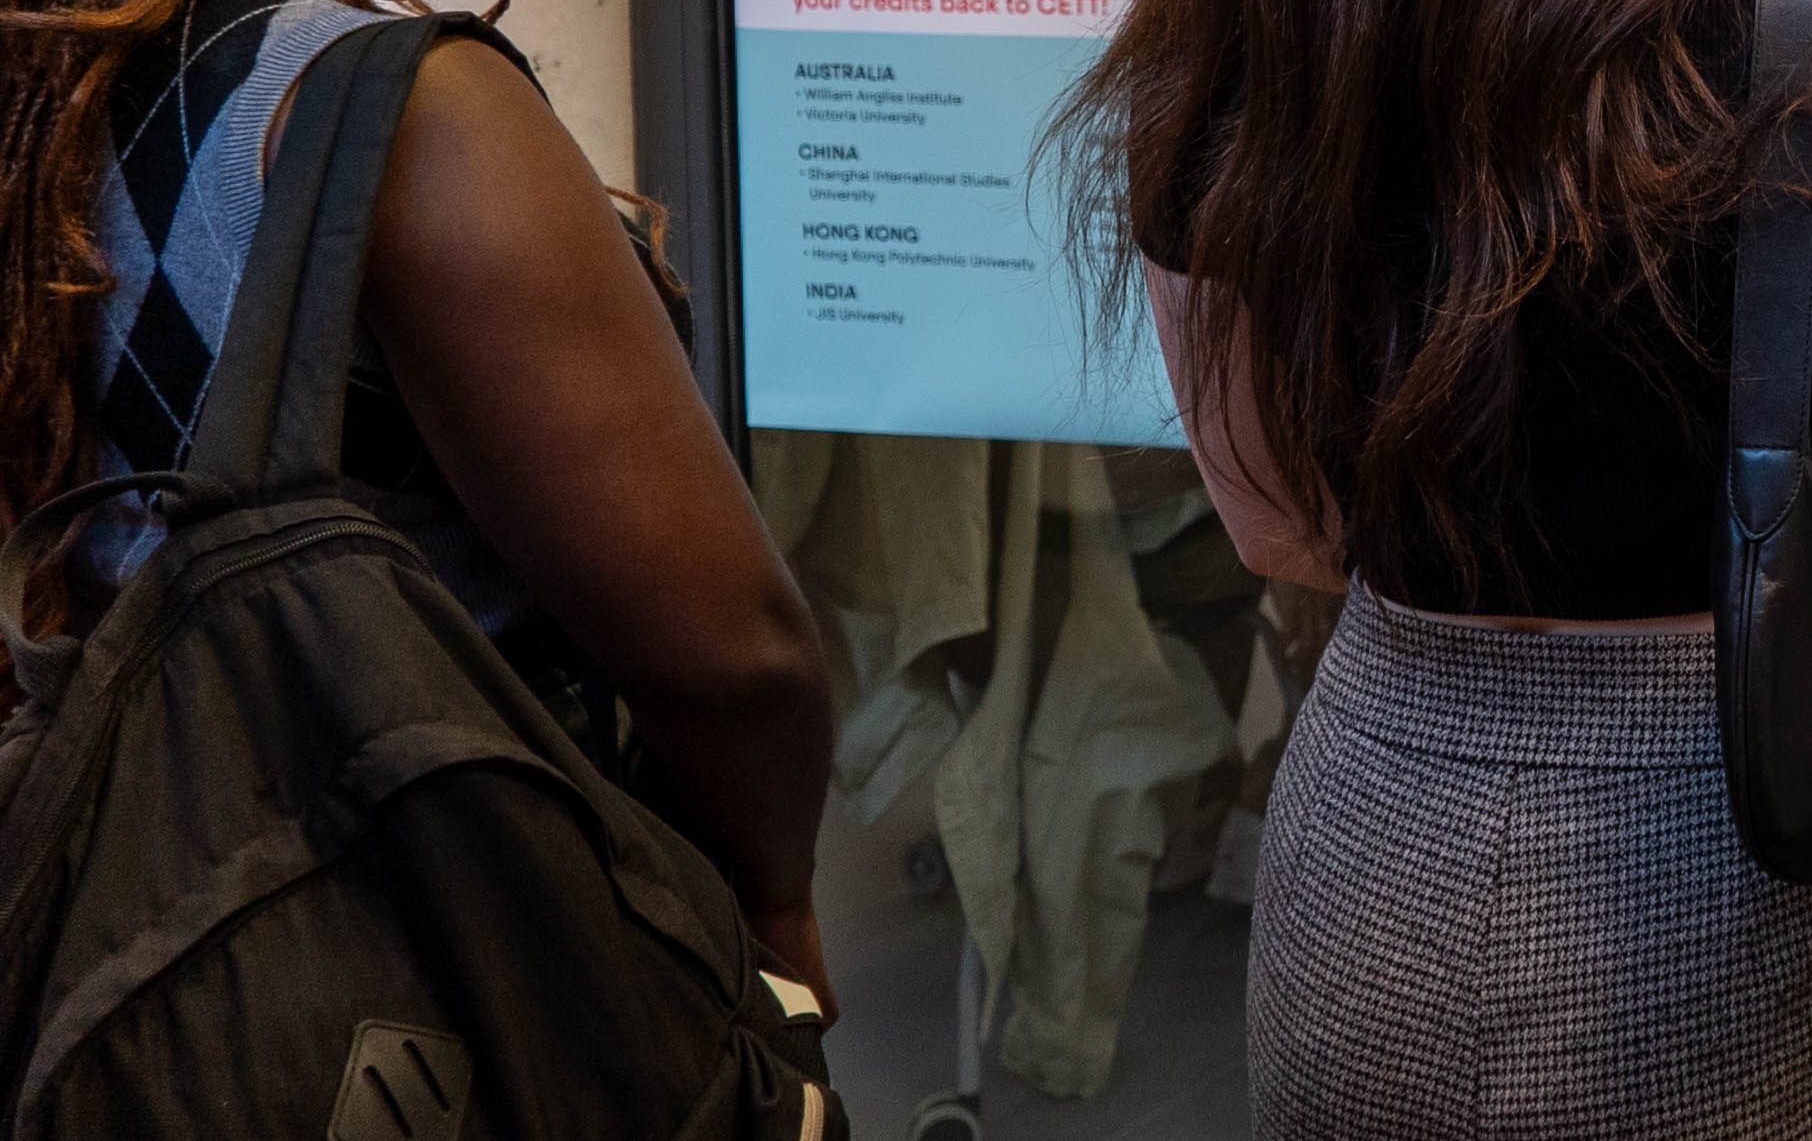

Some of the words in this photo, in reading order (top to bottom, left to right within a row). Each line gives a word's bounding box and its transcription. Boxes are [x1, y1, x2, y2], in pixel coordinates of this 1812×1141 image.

[794, 62, 896, 82] AUSTRALIA
[804, 87, 853, 102] William
[804, 108, 857, 122] Victoria
[860, 109, 926, 126] University
[797, 142, 860, 161] CHINA
[873, 170, 956, 186] International
[959, 173, 1011, 188] Studies
[808, 187, 875, 203] University
[802, 223, 860, 241] HONG
[864, 224, 920, 244] KONG
[811, 247, 849, 264] Hong
[851, 248, 885, 266] Kong
[969, 253, 1037, 271] University
[805, 282, 857, 300] INDIA
[839, 307, 905, 325] University
